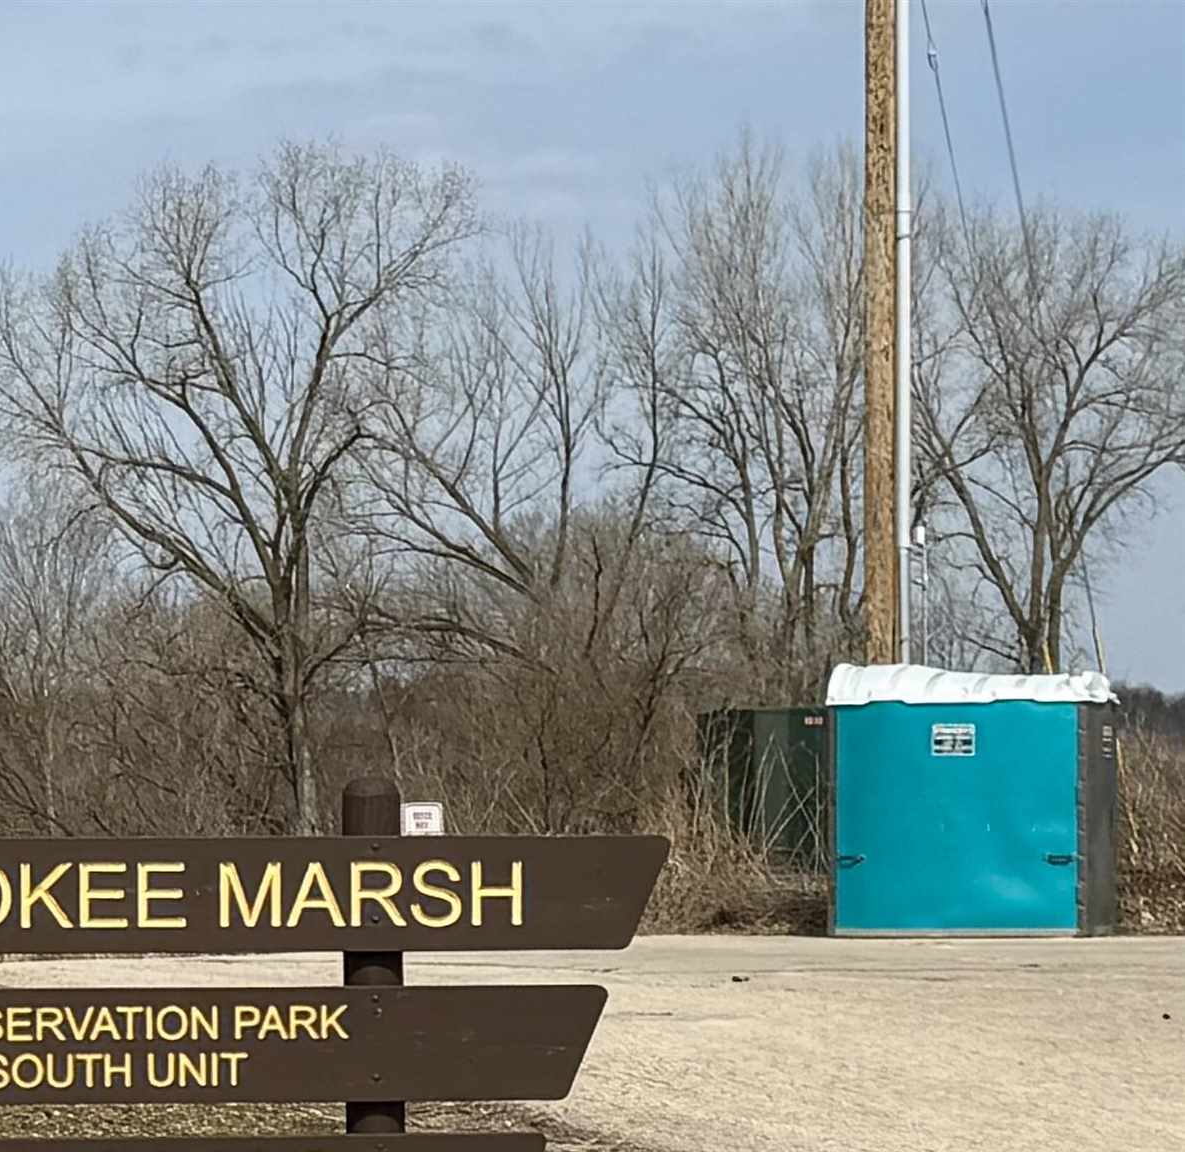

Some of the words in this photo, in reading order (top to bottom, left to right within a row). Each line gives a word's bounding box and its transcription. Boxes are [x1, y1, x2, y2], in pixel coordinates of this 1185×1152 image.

[219, 859, 523, 928] MARSH
[234, 1004, 350, 1040] PARK
[147, 1051, 249, 1088] UNIT
